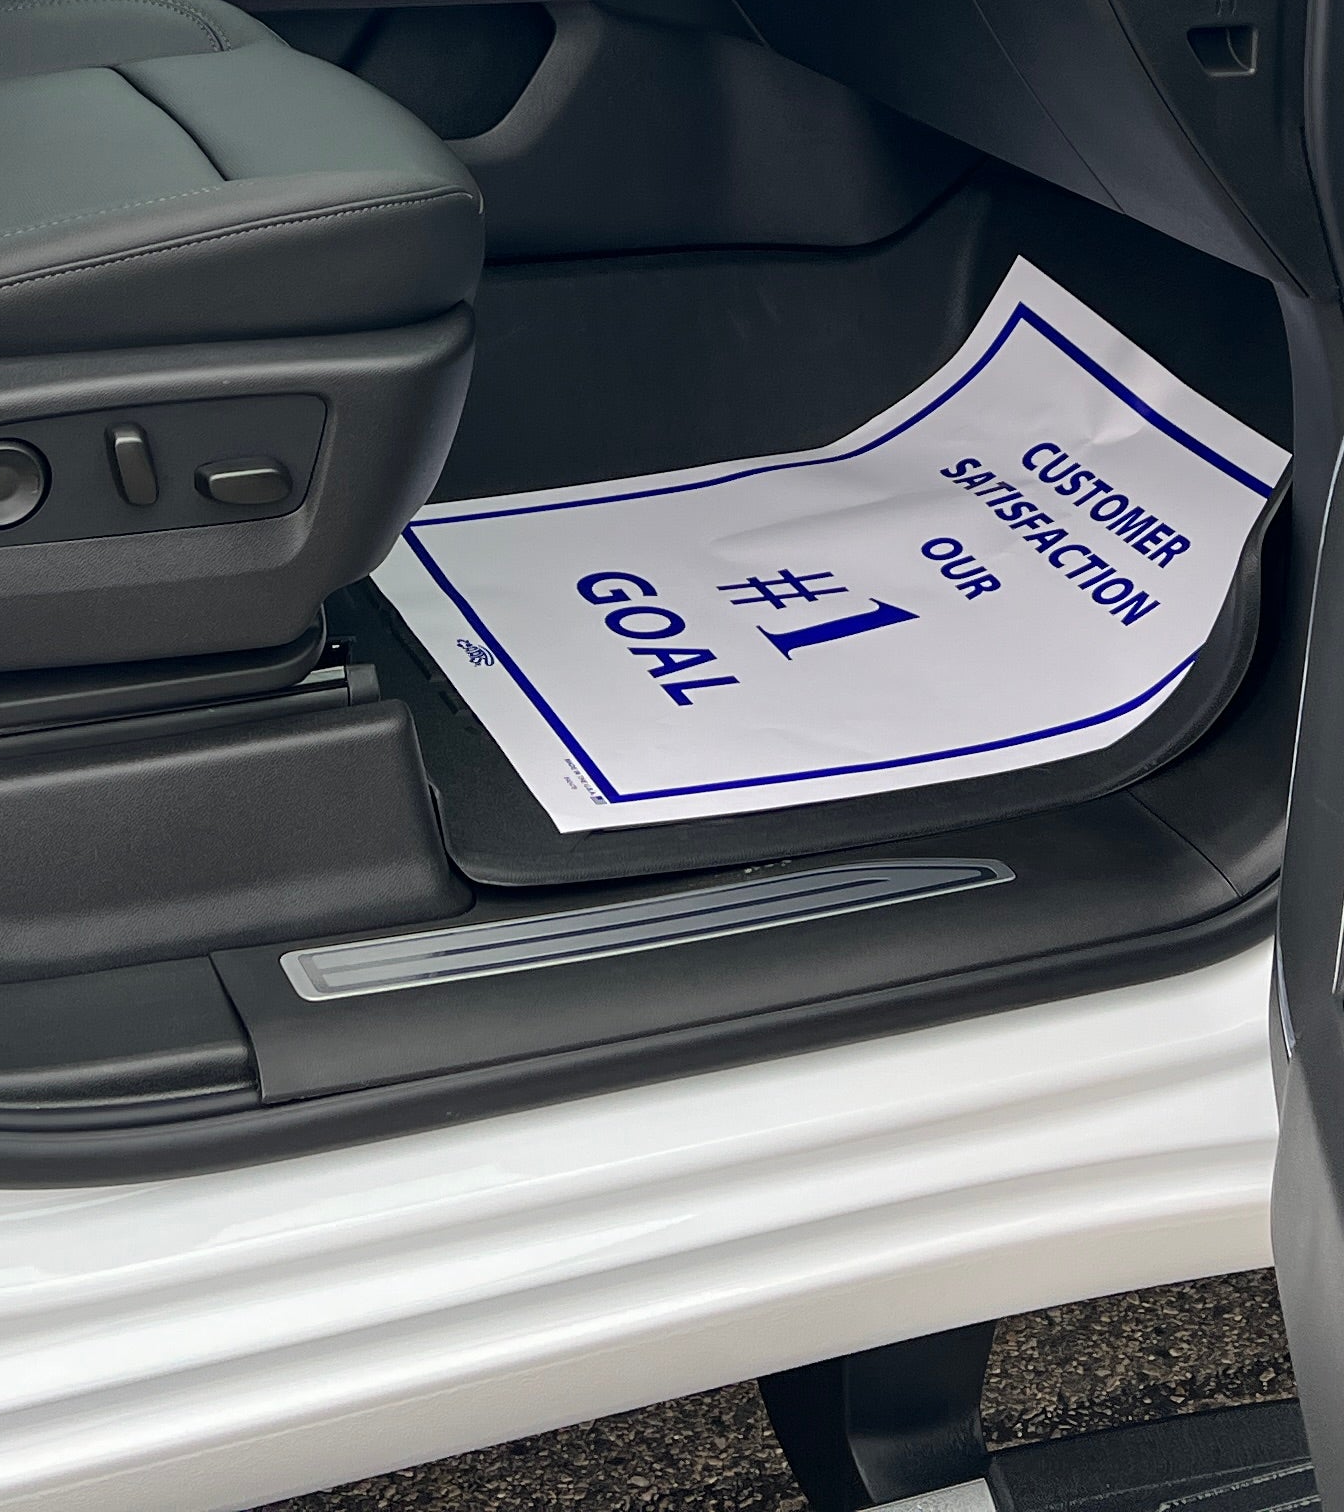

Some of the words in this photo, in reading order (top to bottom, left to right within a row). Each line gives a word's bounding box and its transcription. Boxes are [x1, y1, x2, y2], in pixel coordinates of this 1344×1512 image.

[940, 457, 1160, 627] SATISFACTION
[1023, 441, 1191, 568] CUSTOMER
[716, 568, 920, 660] #1
[920, 536, 1003, 601] OUR
[576, 571, 739, 707] GOAL
